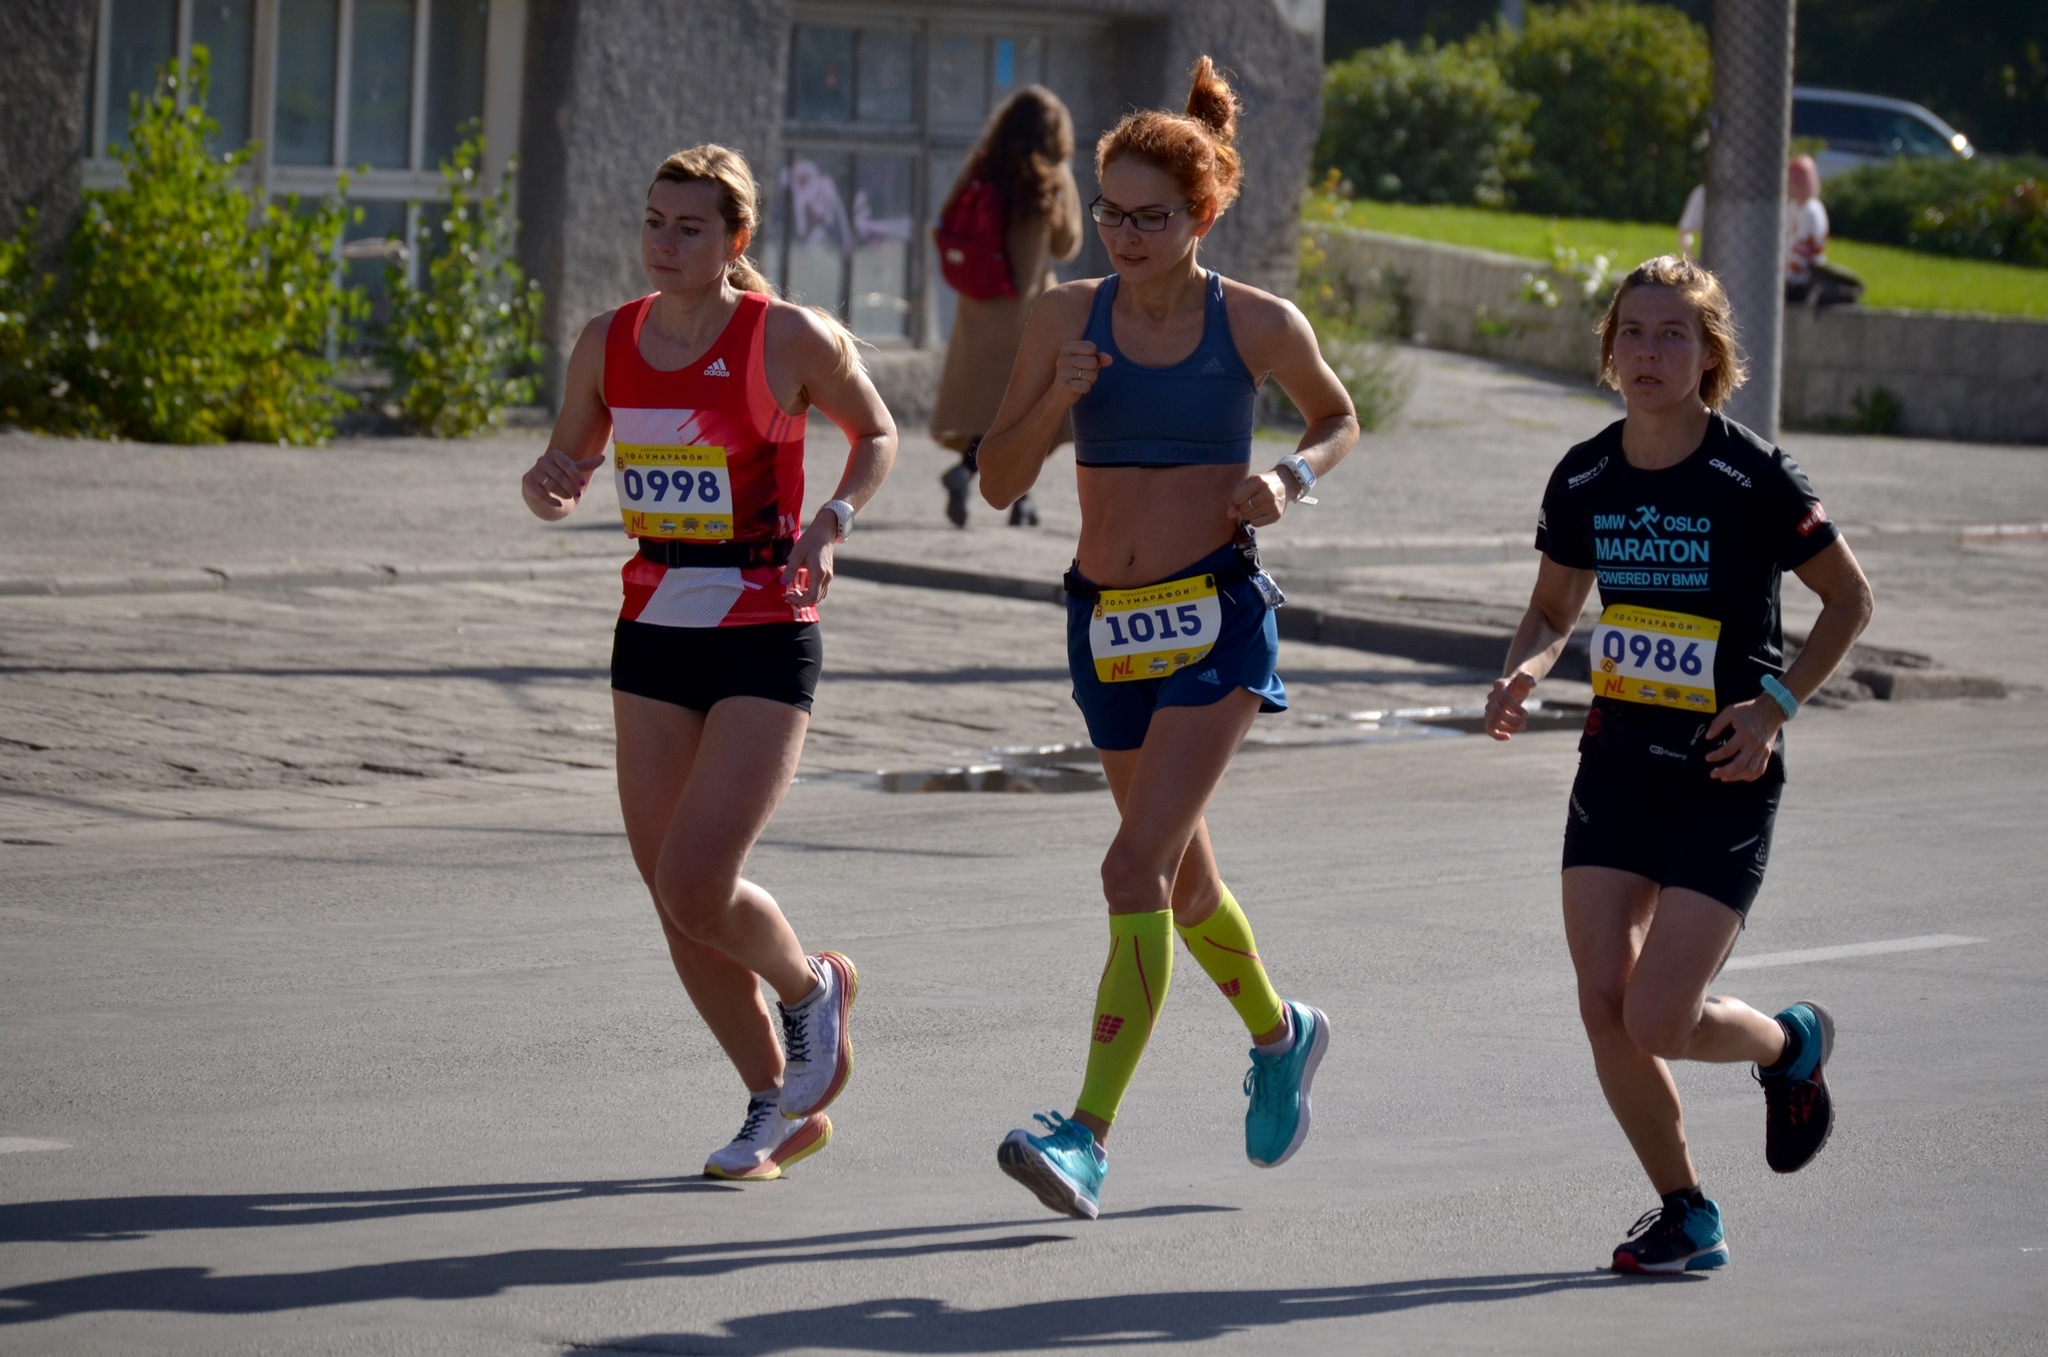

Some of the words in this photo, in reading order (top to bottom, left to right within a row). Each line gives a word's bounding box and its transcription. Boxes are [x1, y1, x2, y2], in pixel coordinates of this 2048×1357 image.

[703, 369, 731, 377] adidas
[1708, 458, 1746, 482] CRAFT
[624, 469, 720, 503] 0998
[631, 512, 648, 533] NL
[1594, 515, 1626, 530] BMW
[1663, 516, 1711, 533] OSLO
[1594, 537, 1710, 563] MARATON
[1597, 570, 1650, 585] POWERED
[1653, 572, 1670, 587] BY
[1672, 573, 1709, 587] BMW
[1106, 604, 1202, 647] 1015
[1602, 630, 1702, 677] 0986
[1111, 654, 1134, 681] NL
[1197, 673, 1221, 686] adidas
[1603, 675, 1625, 696] NL
[1093, 1033, 1114, 1045] cep
